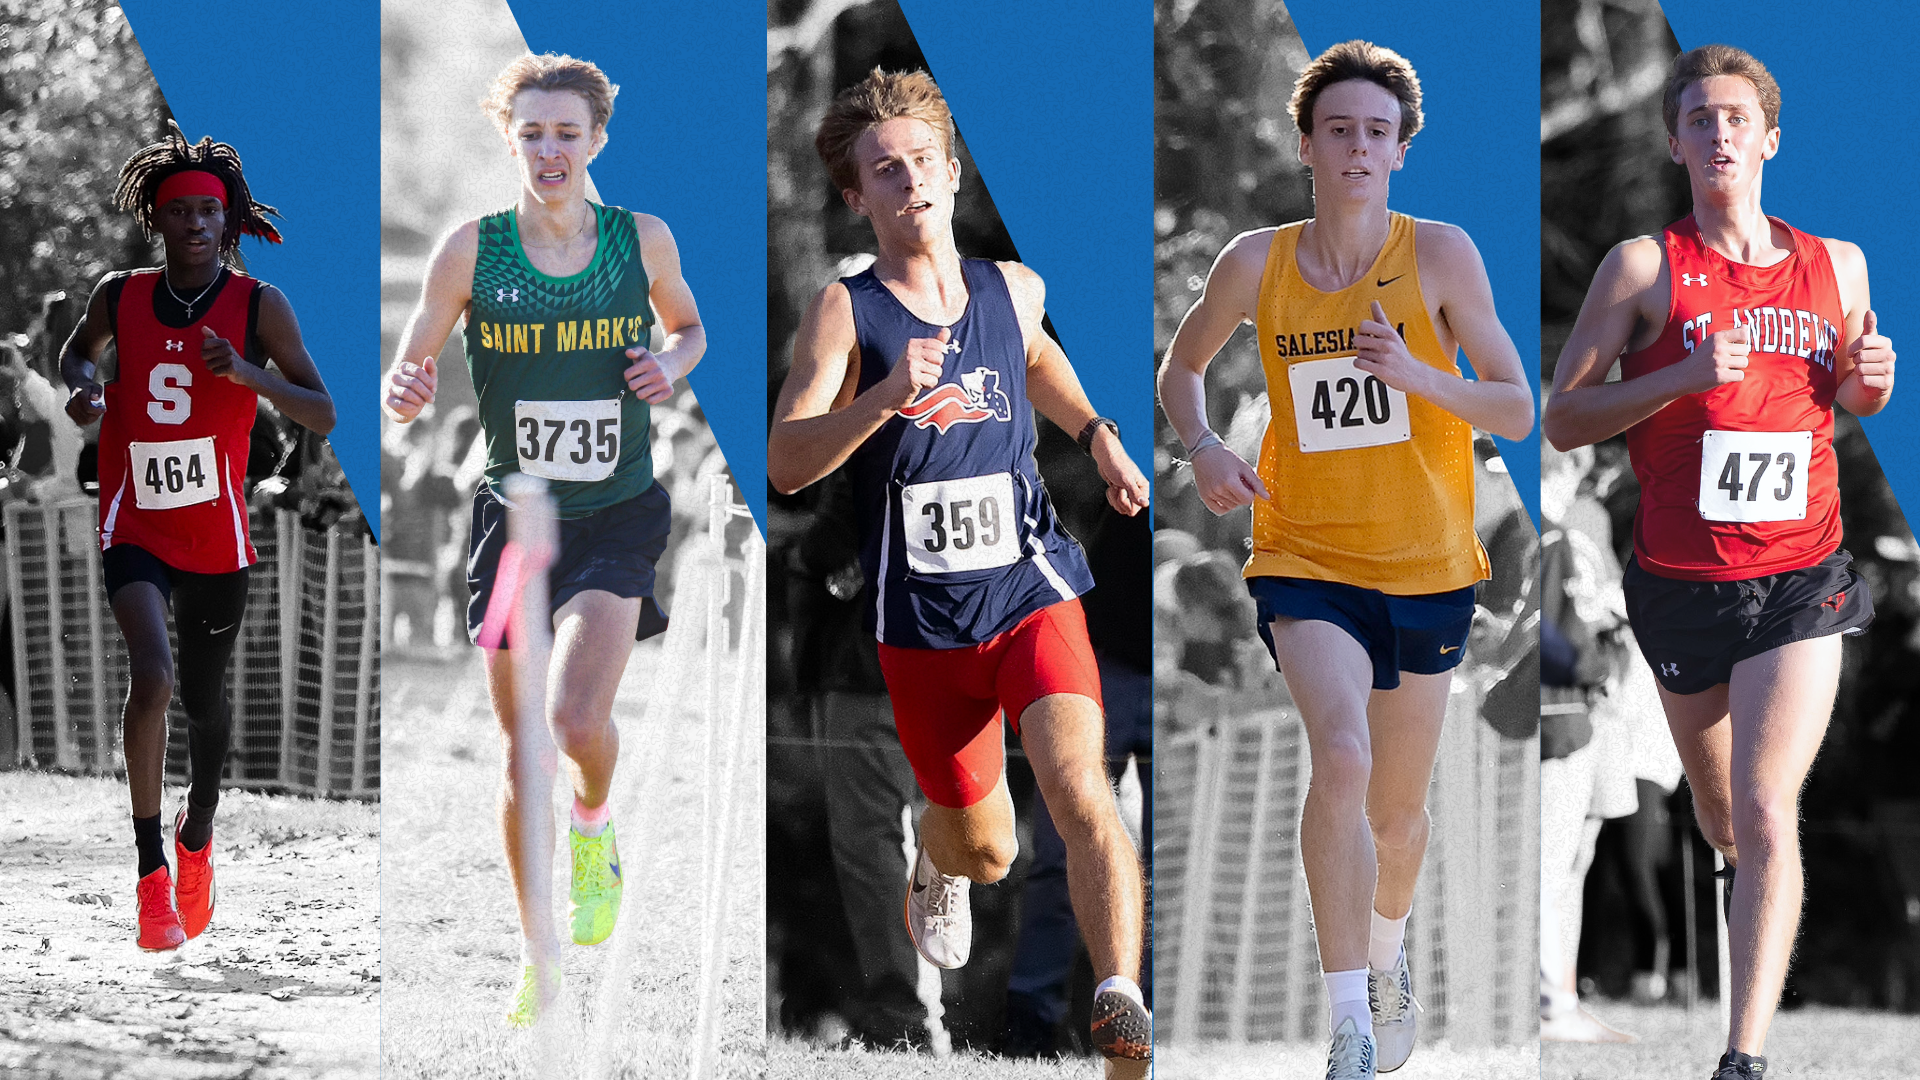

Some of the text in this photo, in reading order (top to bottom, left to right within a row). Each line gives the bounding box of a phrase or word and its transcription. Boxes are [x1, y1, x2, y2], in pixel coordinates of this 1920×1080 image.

[480, 321, 545, 354] SAINT
[1275, 322, 1407, 358] SALESIA
[1682, 311, 1712, 354] ST
[147, 363, 193, 425] S
[1311, 375, 1391, 430] 420
[518, 417, 618, 465] 3735
[145, 453, 206, 495] 464
[1717, 452, 1796, 502] 473
[921, 496, 1001, 553] 359
